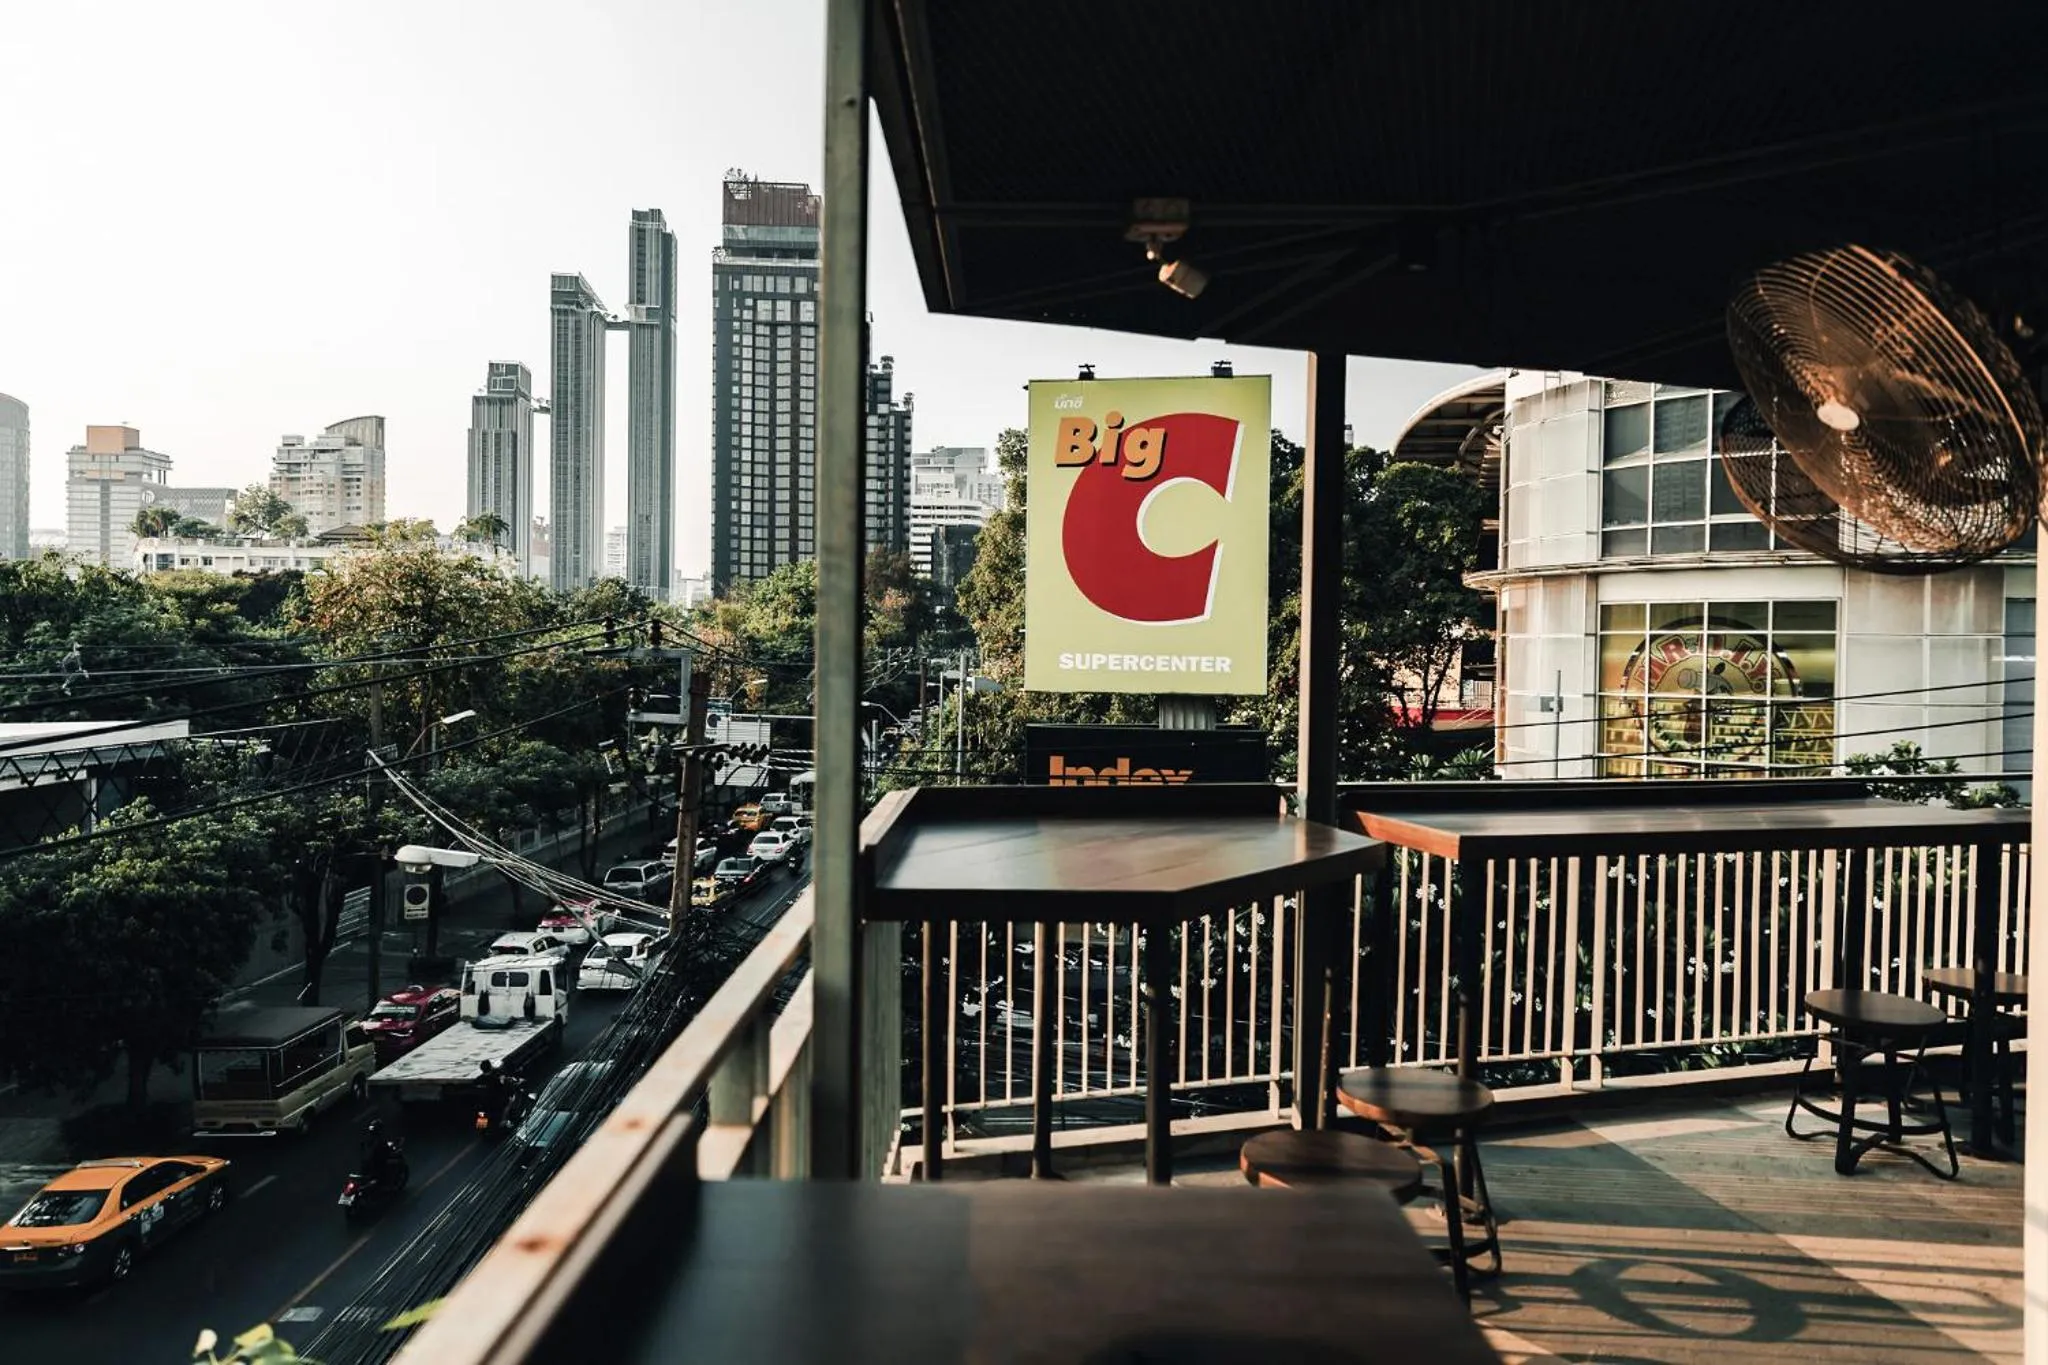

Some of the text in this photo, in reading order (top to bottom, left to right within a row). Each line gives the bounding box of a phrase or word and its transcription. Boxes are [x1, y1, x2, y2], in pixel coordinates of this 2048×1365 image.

[1054, 410, 1245, 626] Big C
[1058, 652, 1233, 673] SUPERCENTER
